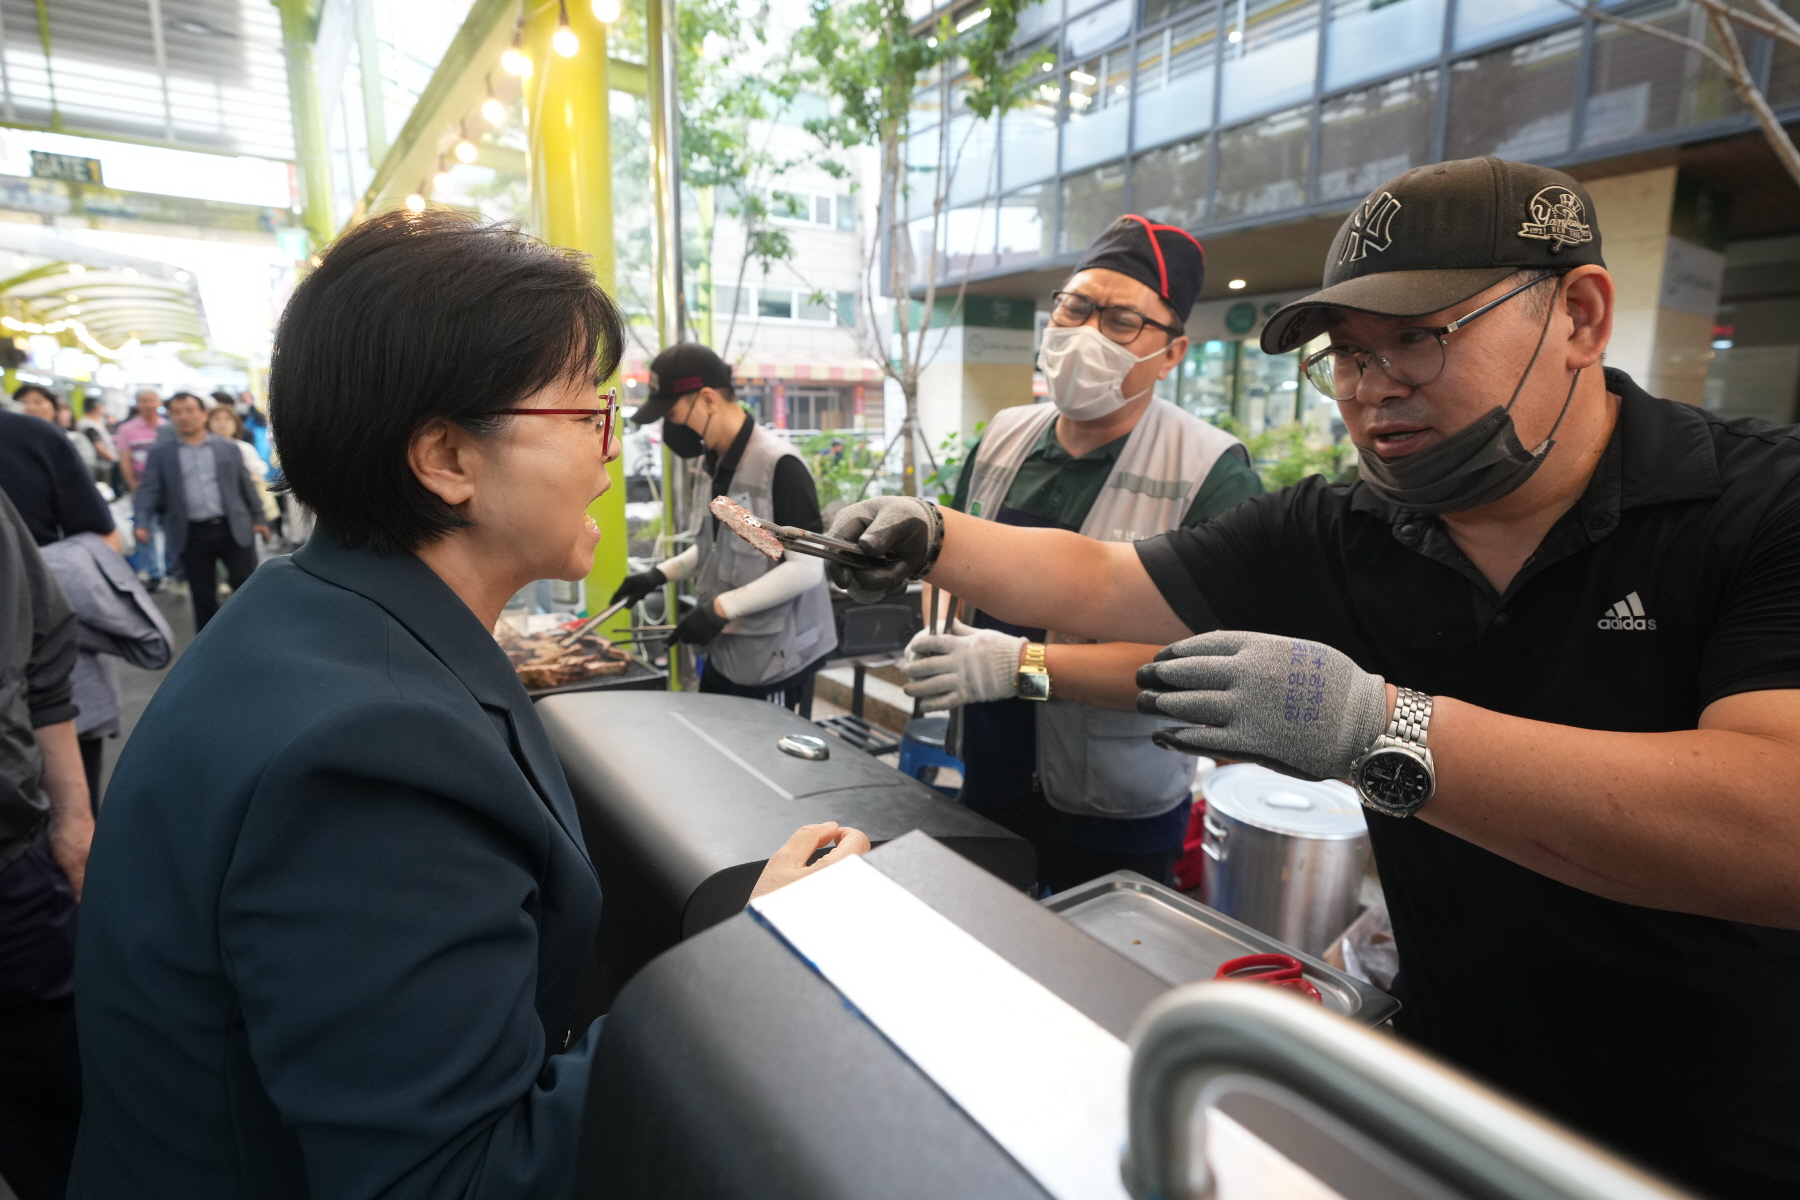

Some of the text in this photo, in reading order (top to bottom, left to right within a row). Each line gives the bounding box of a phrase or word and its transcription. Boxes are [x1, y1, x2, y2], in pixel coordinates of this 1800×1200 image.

[33, 152, 101, 183] GATE 1
[1597, 615, 1657, 631] adidas
[1284, 641, 1307, 721] 안전은 기본
[1303, 674, 1326, 722] 안심은
